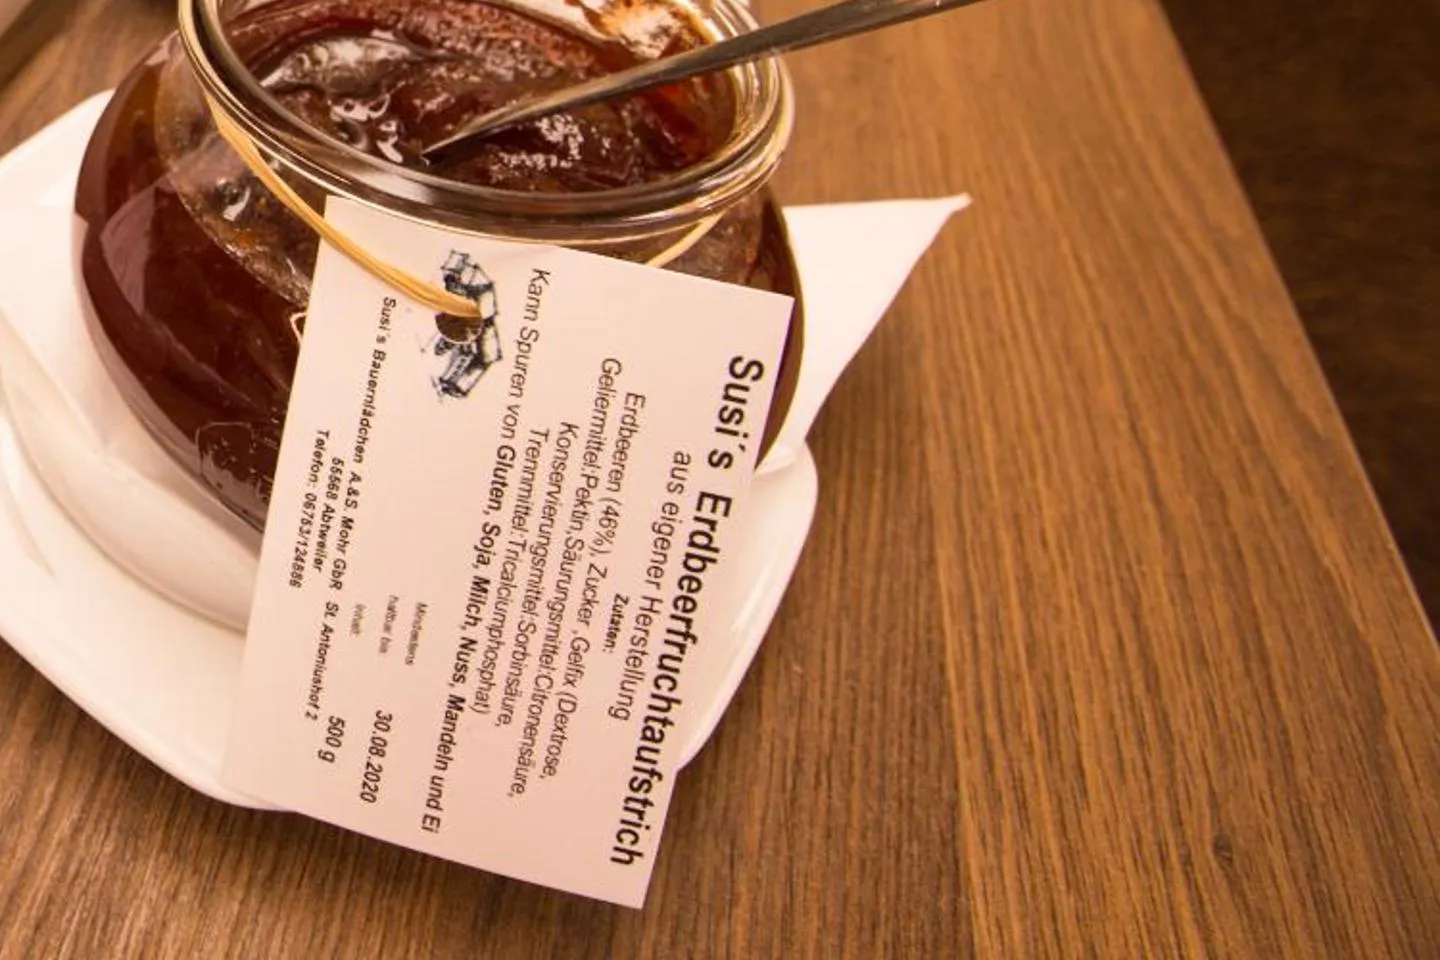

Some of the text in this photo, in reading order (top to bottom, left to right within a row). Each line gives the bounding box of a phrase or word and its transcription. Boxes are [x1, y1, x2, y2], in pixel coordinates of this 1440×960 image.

[605, 391, 647, 493] Erdbeeren
[312, 502, 336, 574] Abtweiler
[336, 515, 355, 556] Mohr
[420, 268, 552, 834] Kann Spuren von Gluten, Soja, Milch, Nuss, Mandeln und Ei
[328, 558, 347, 591] GbR
[576, 562, 608, 628] Zucker
[607, 450, 692, 722] aus eigener Herstellung
[602, 593, 630, 654] Zutaten:
[307, 622, 335, 711] Antoniushof
[609, 490, 733, 867] Erdbeerfruchtaufstrich
[304, 710, 319, 721] 2
[325, 715, 346, 749] 500
[538, 690, 579, 780] (Dextrose,
[317, 748, 336, 764] g
[358, 709, 394, 804] 30.08.2020
